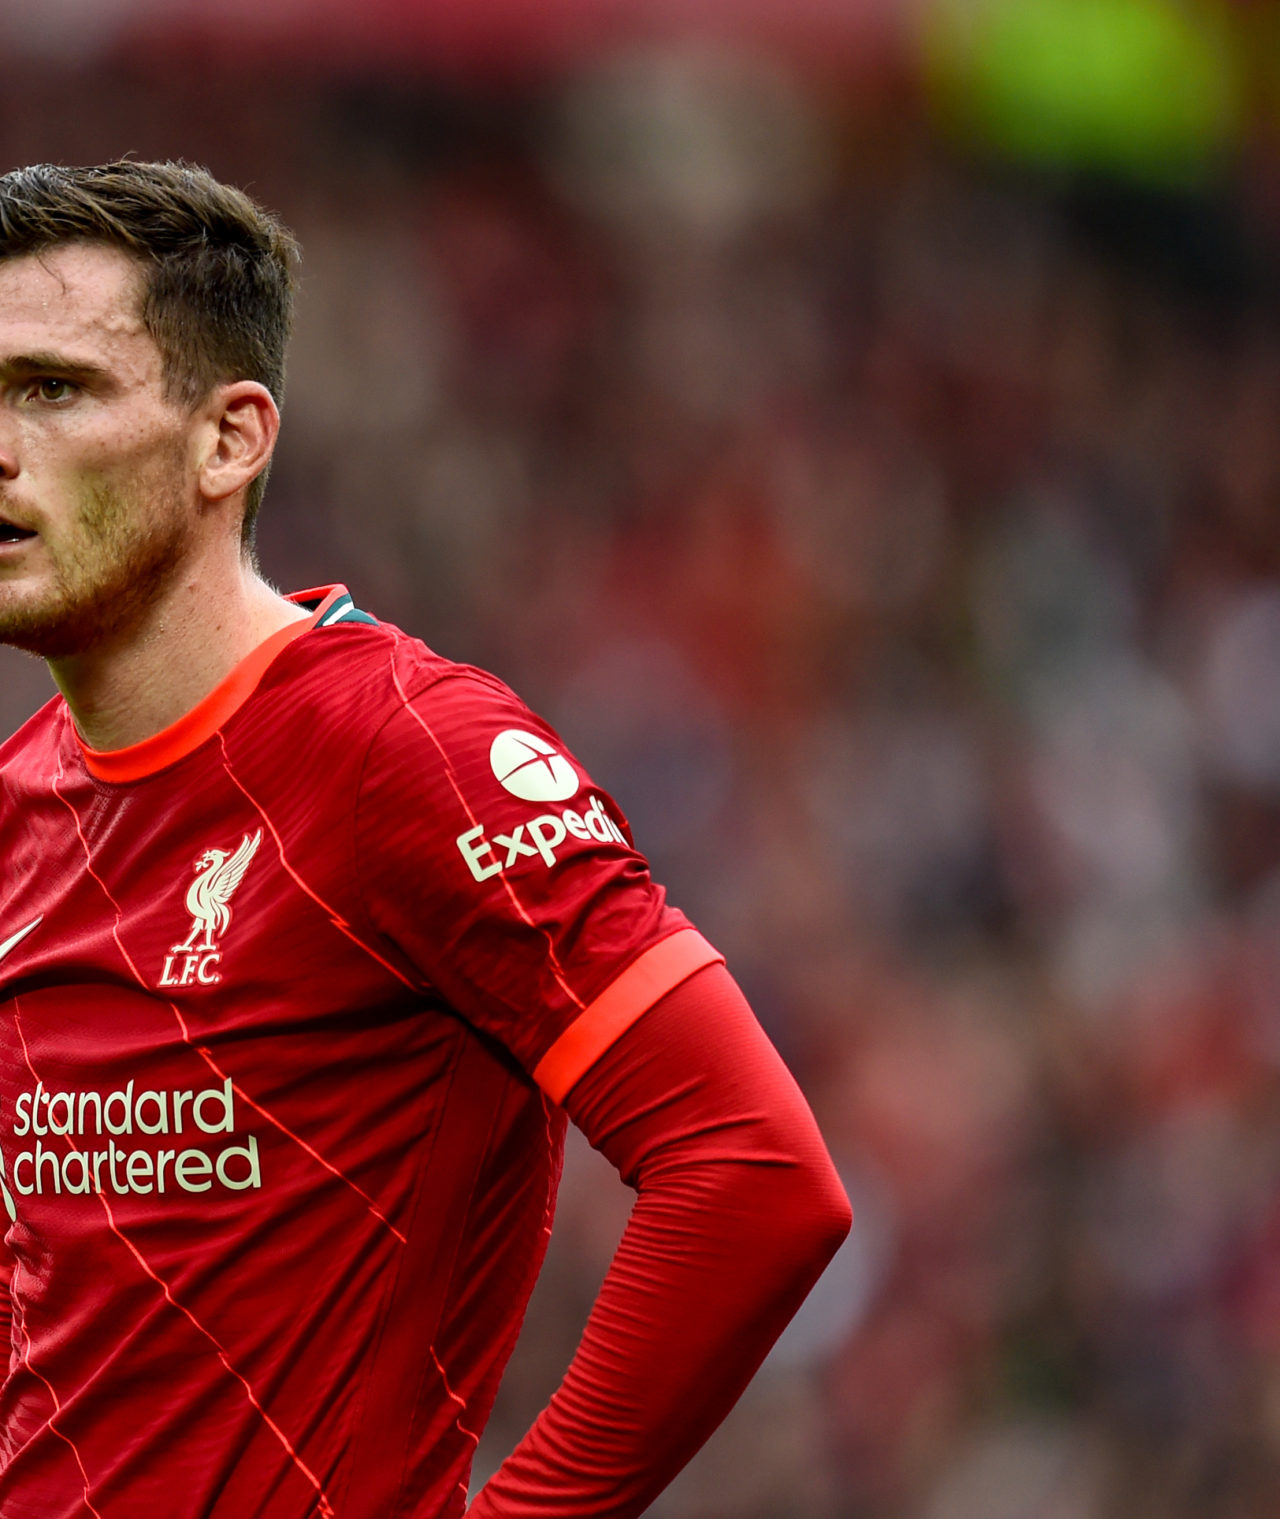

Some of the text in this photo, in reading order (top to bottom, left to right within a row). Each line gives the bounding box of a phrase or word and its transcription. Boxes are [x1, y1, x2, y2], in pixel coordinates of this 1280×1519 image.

[456, 795, 630, 882] Expedi
[160, 954, 220, 985] L.F.C.
[13, 1077, 234, 1136] standard
[13, 1135, 261, 1195] chartered
